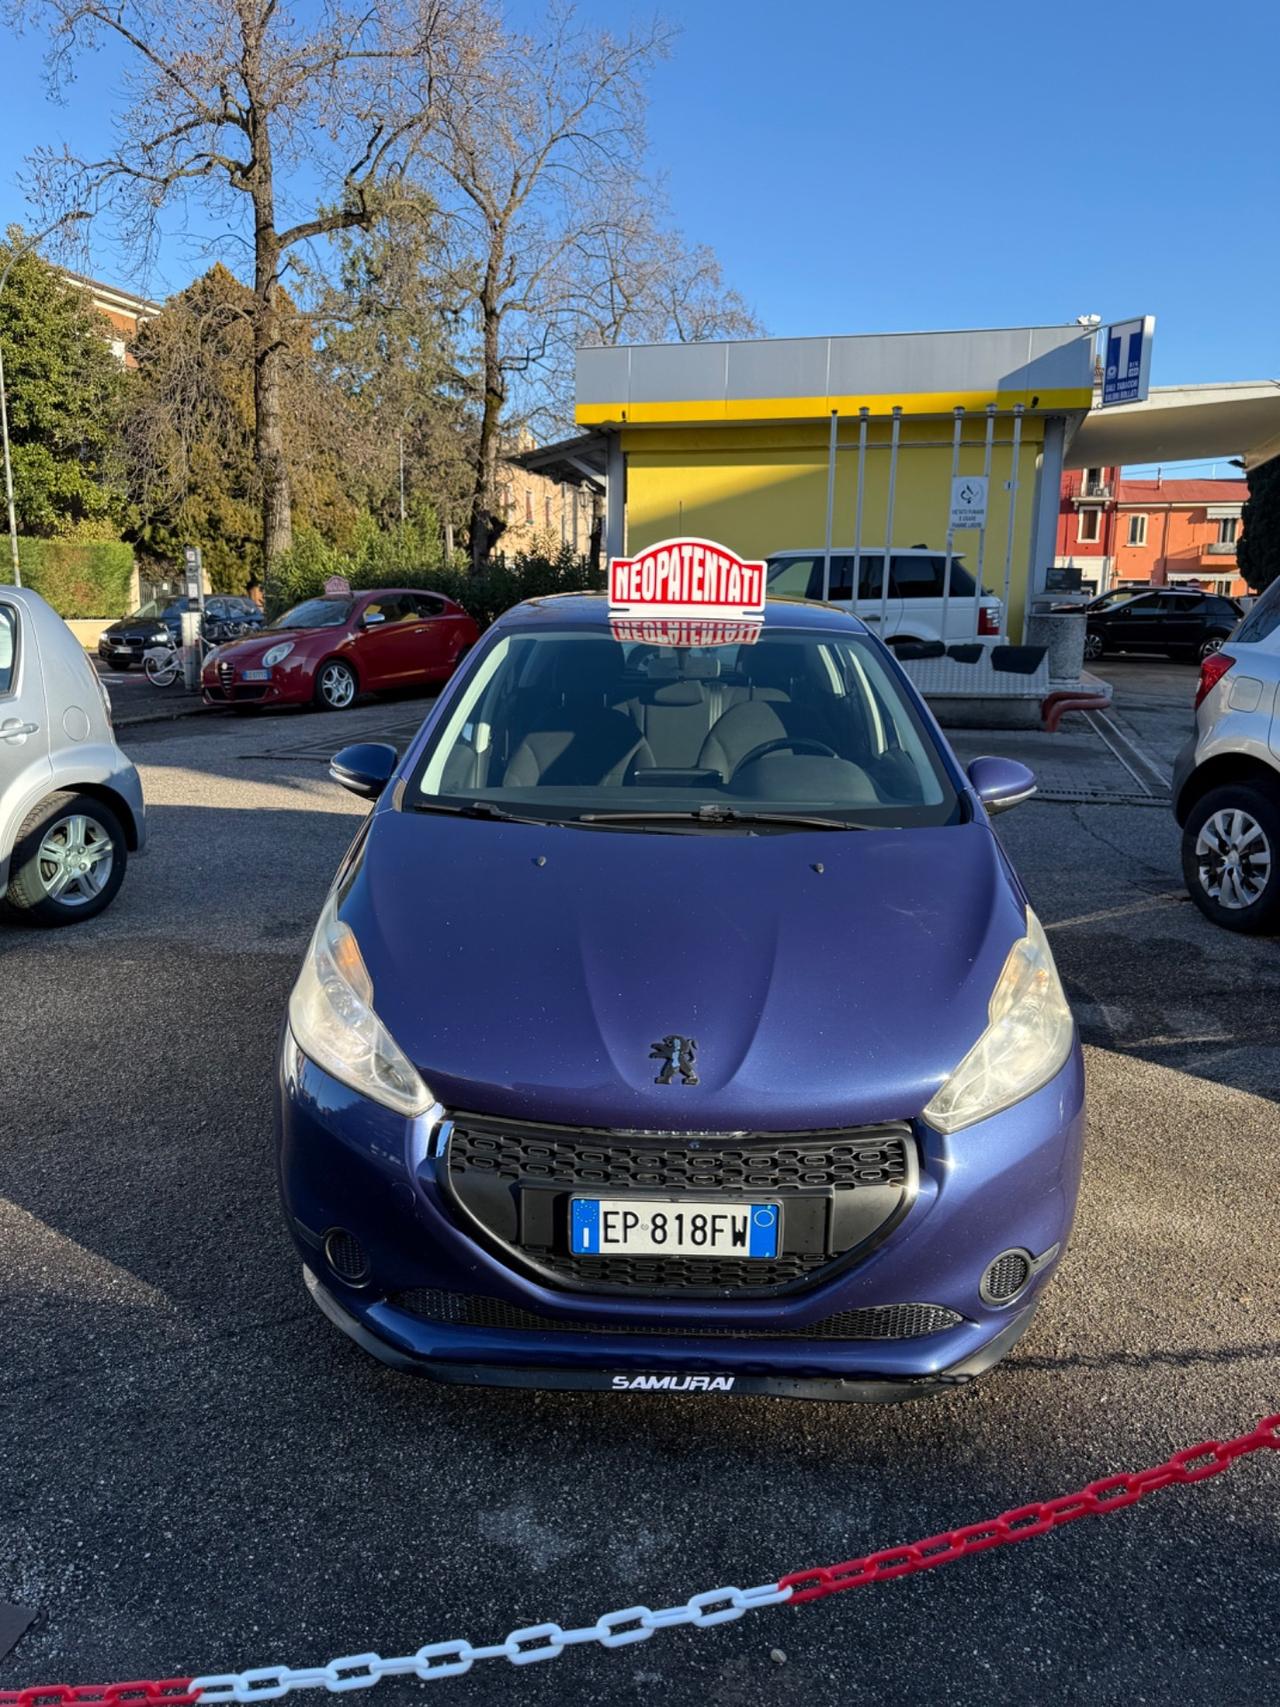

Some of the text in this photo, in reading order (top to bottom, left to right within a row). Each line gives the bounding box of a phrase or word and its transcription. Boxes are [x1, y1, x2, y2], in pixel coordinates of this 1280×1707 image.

[1110, 320, 1143, 379] T
[615, 545, 760, 603] NEOPATENTATI
[603, 1211, 639, 1244] EP
[651, 1213, 748, 1247] 818FW
[612, 1376, 735, 1390] SAMURAI
